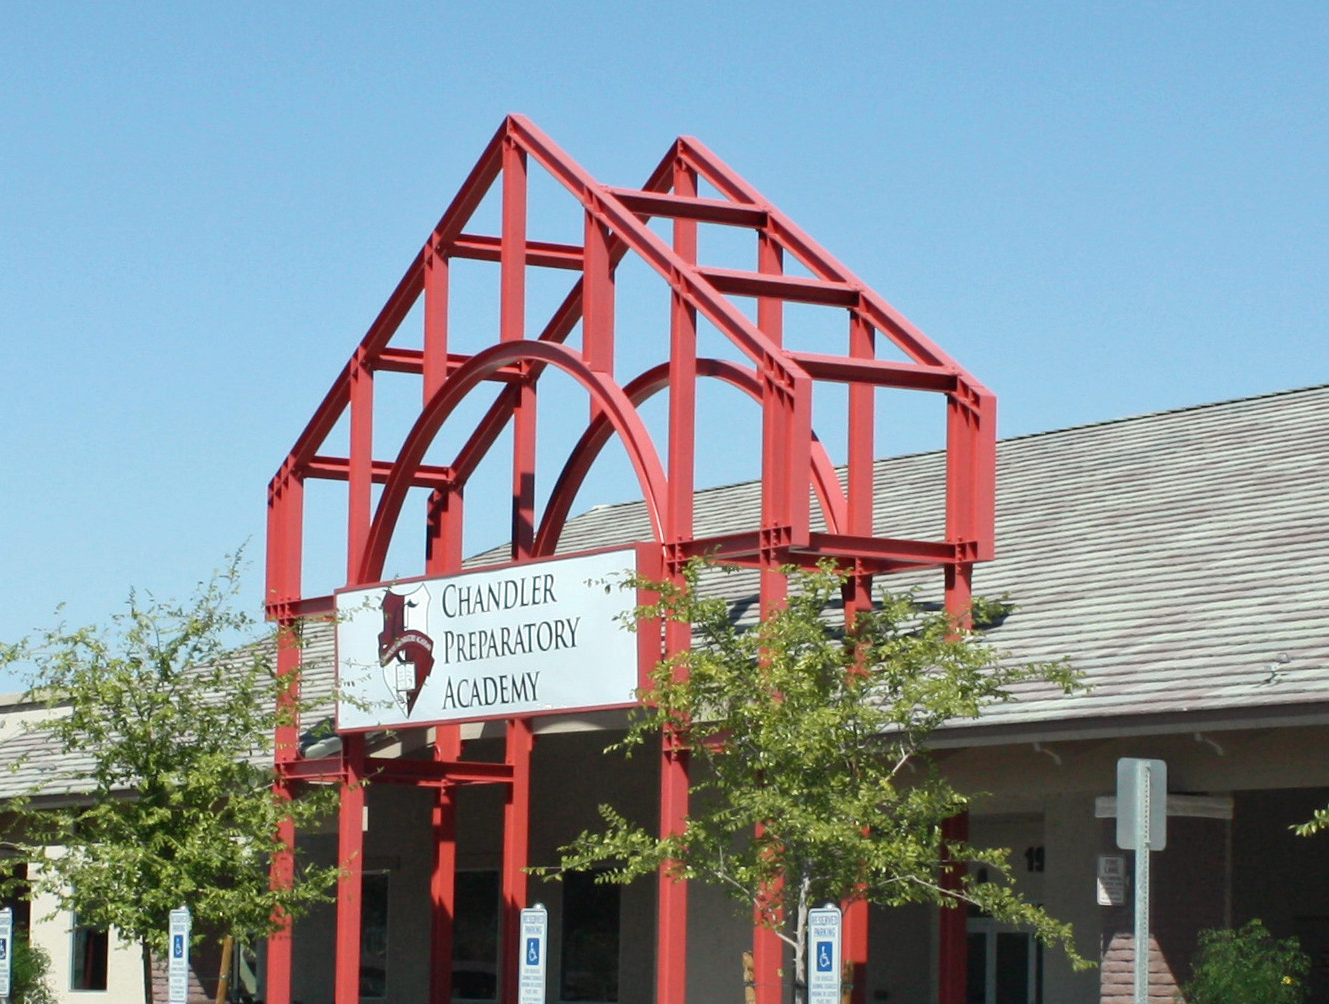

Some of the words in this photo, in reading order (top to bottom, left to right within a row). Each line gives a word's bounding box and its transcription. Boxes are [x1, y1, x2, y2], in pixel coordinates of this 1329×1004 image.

[442, 573, 557, 618] CHANDLER
[443, 616, 581, 664] PREPARATORY
[442, 671, 540, 710] ACADEMY
[1024, 846, 1045, 873] 19
[814, 927, 836, 938] PARKING
